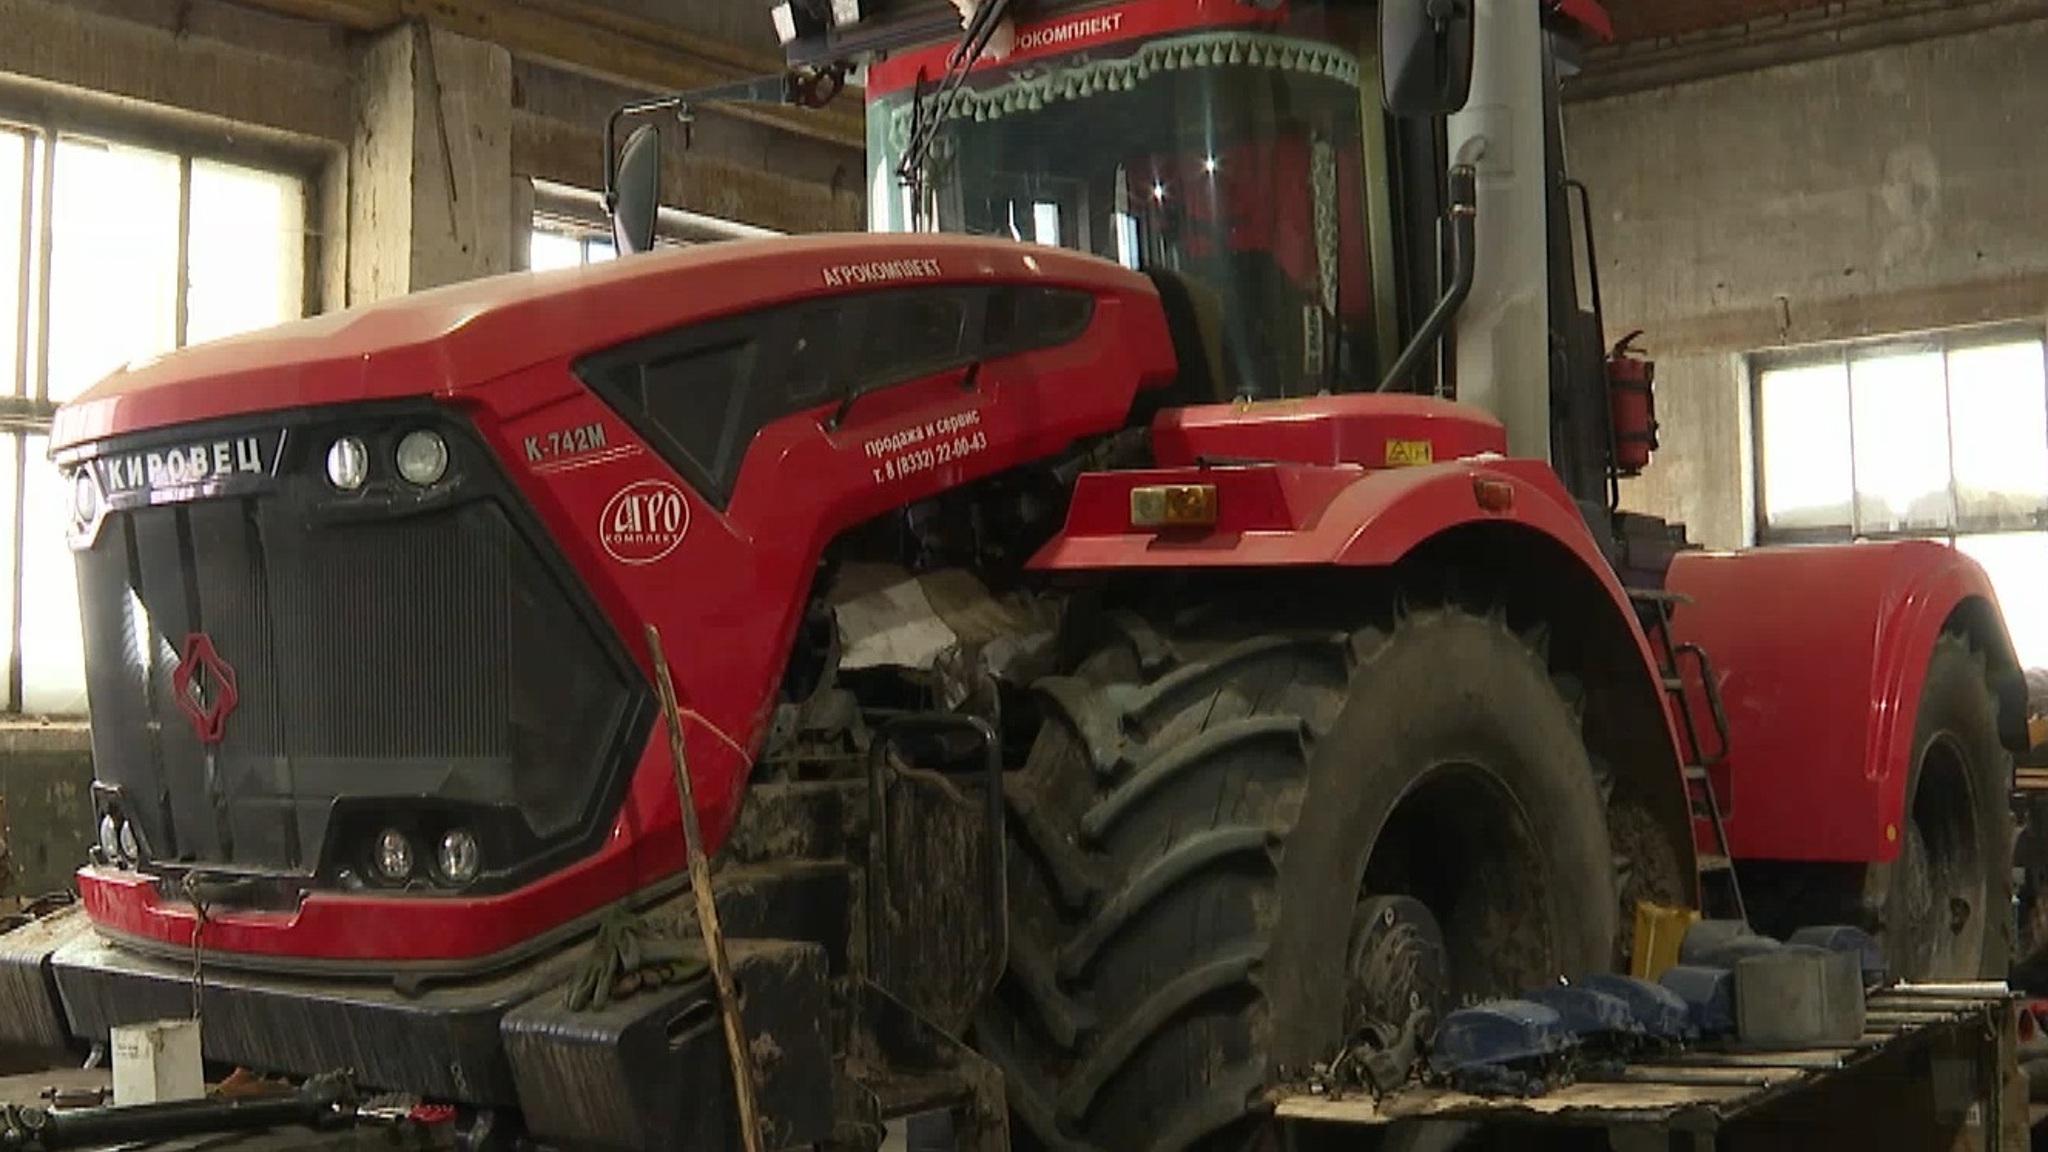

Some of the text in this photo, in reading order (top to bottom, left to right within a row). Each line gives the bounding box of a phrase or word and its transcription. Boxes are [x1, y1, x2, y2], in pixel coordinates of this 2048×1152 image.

[823, 258, 941, 287] АГРОКОМПЛЕКТ
[925, 423, 935, 437] и
[937, 410, 980, 434] сервис
[524, 424, 606, 462] К-742М
[885, 460, 895, 480] 8
[896, 448, 934, 480] (8332)
[936, 432, 987, 464] 22-00-43
[109, 438, 262, 489] КИРОВЕЦ
[614, 491, 681, 532] АГРО
[606, 533, 677, 544] КОМПЛЕКТ
